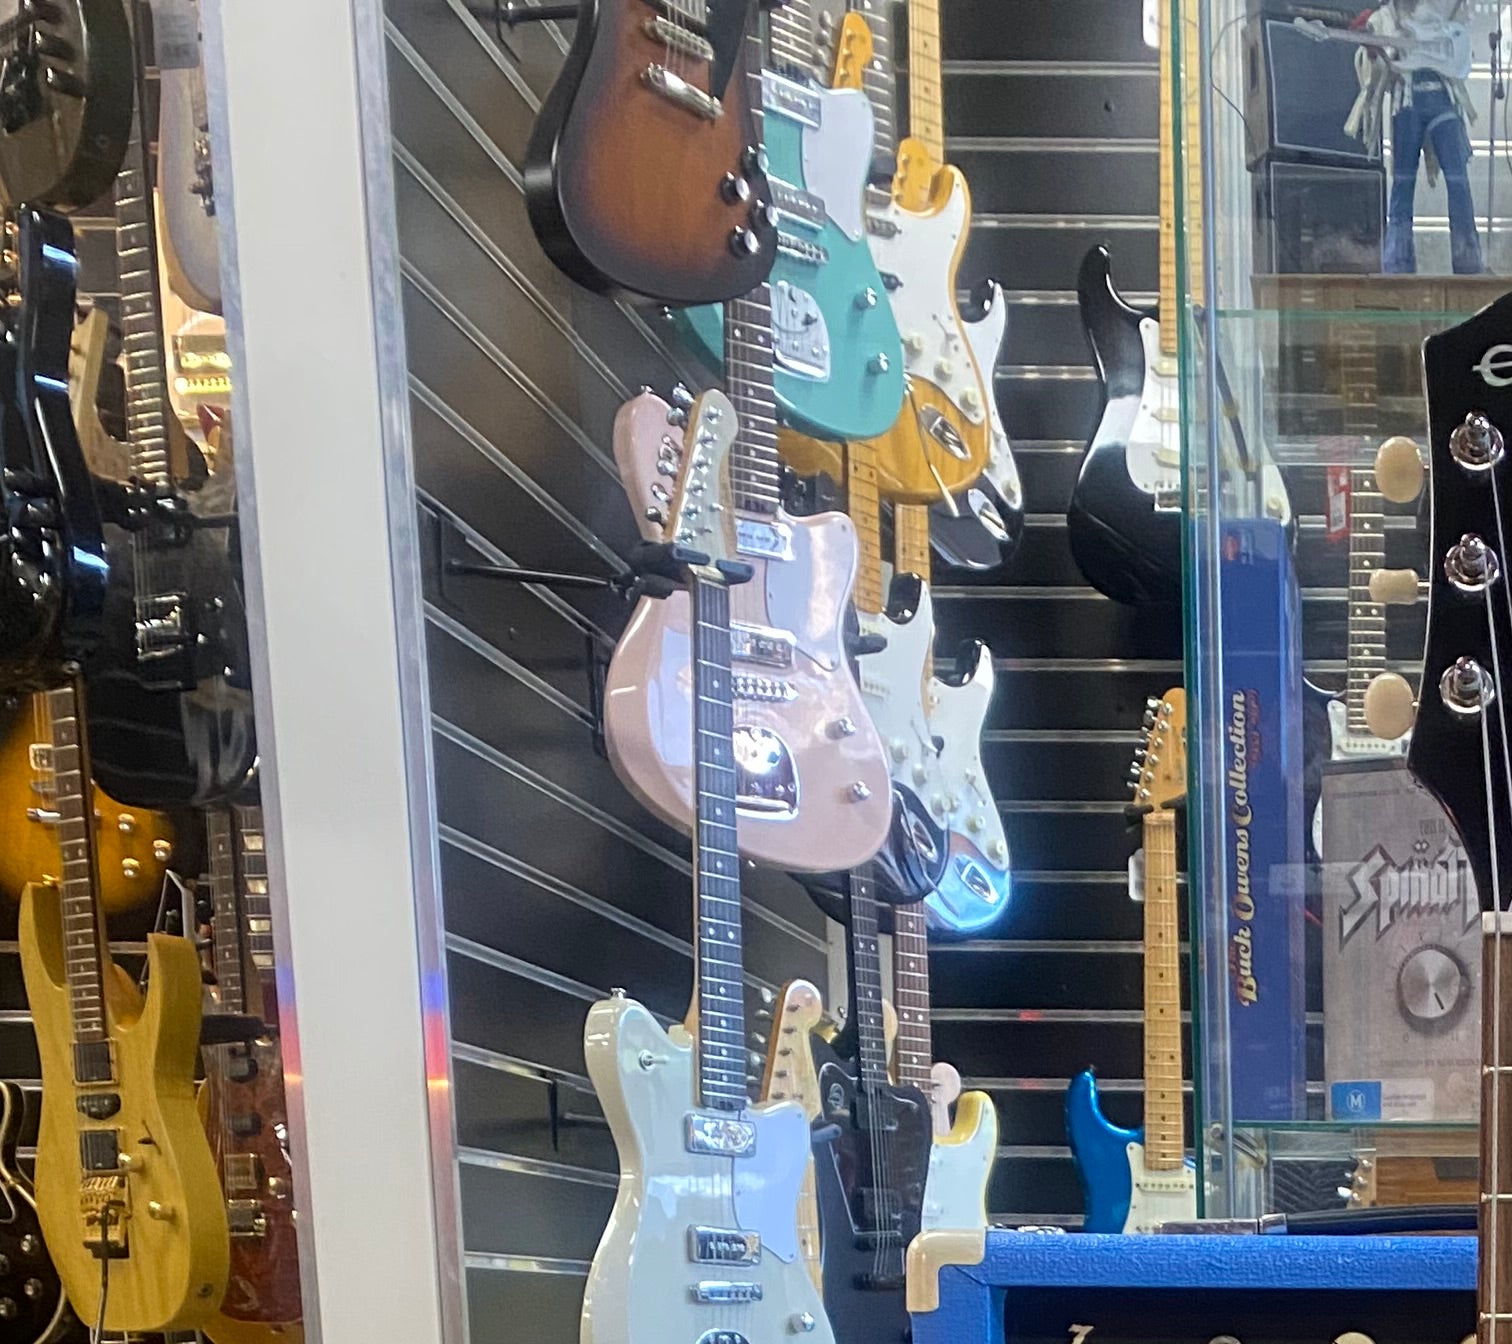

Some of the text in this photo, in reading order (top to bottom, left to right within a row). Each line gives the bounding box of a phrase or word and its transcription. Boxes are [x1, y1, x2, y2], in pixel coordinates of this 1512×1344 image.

[1229, 689, 1257, 1007] Buck Owens Collection
